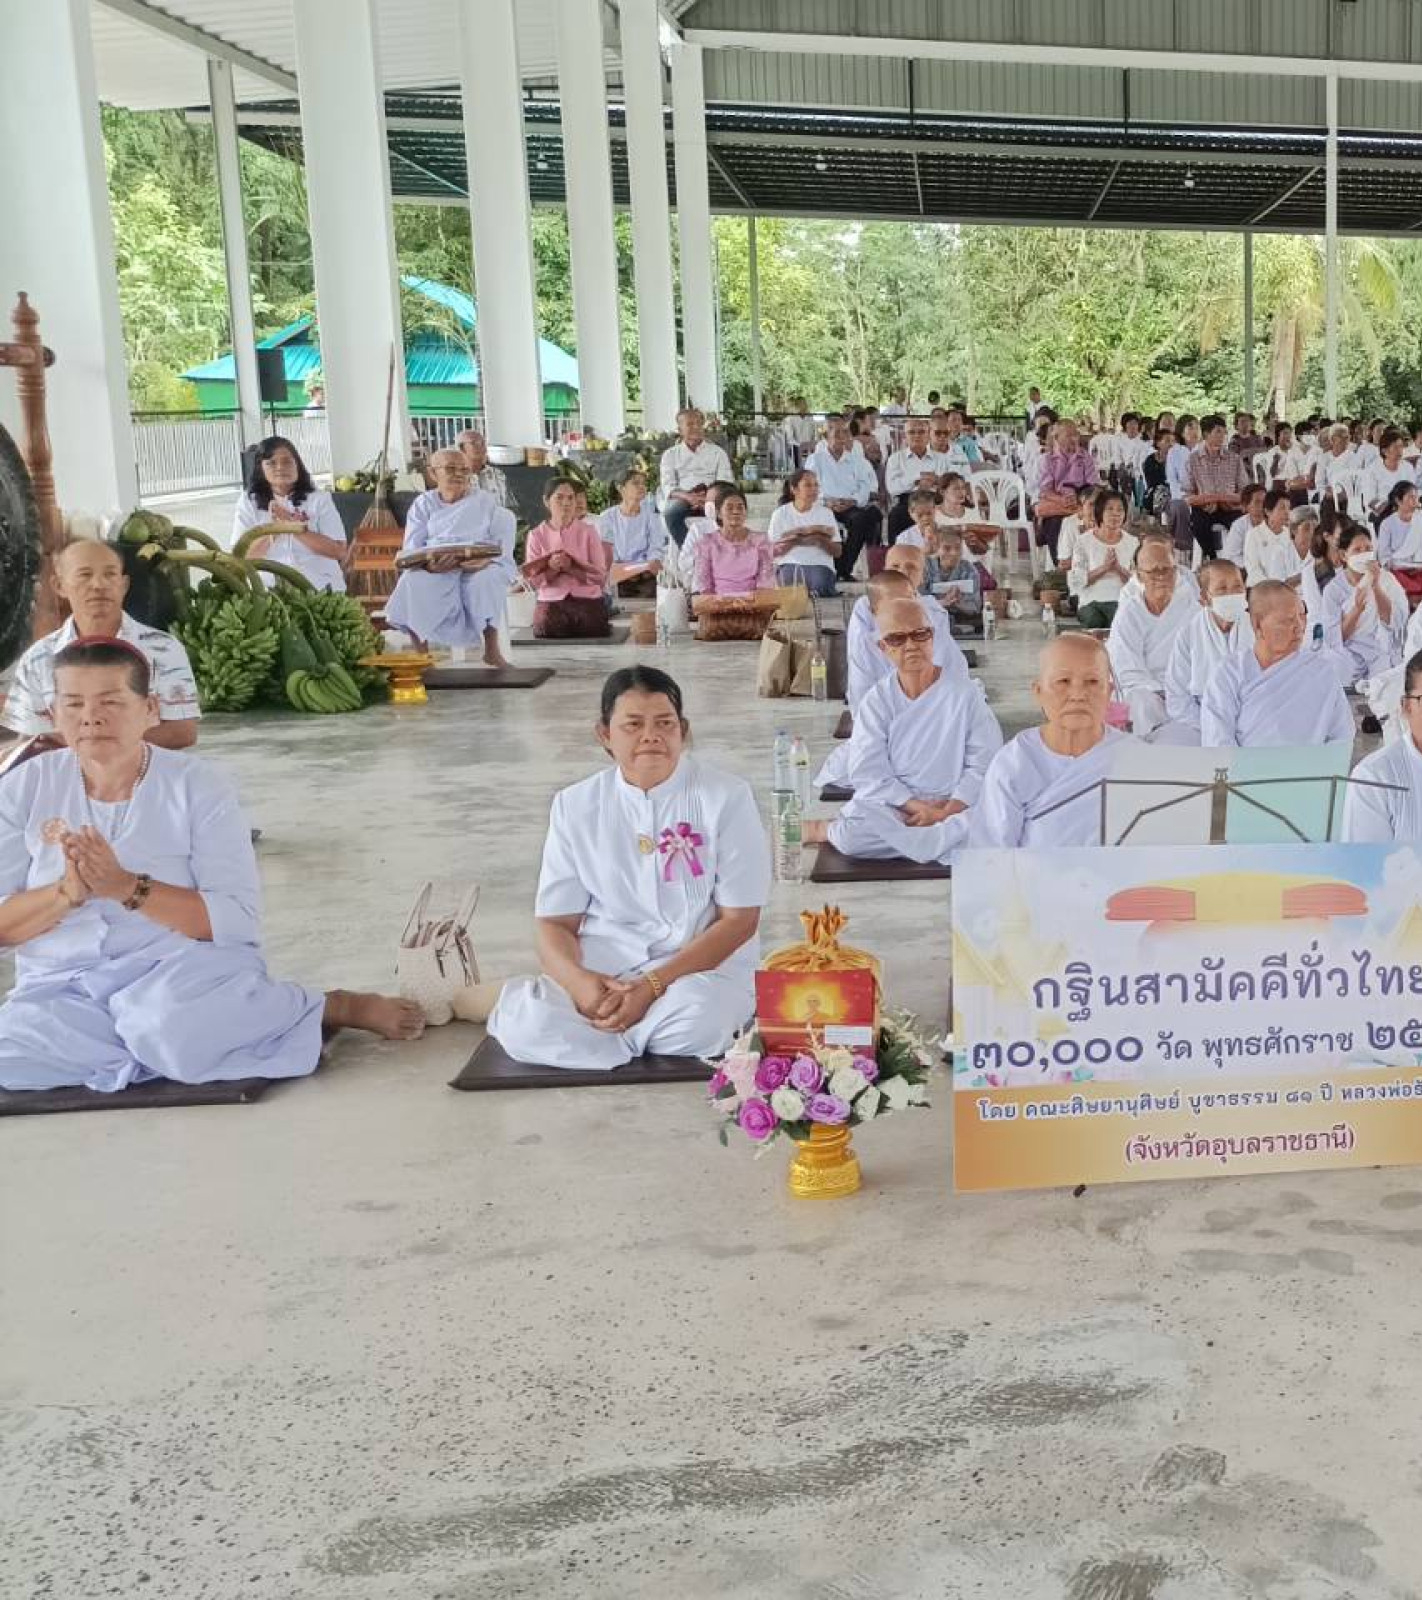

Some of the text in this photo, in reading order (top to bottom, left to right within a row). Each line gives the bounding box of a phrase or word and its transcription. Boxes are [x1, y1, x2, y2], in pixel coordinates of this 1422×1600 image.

[972, 1036, 1144, 1073] ๓๐,๐๐๐
[1156, 1030, 1193, 1060] วัด
[1201, 1026, 1354, 1069] พุทธศักราช
[978, 1100, 1016, 1120] โดย
[1026, 1089, 1180, 1118] คณะศิษยานุศิษย์
[1188, 1091, 1278, 1115] บูชาธรรม
[1319, 1082, 1334, 1101] ปี
[1125, 1122, 1356, 1164] (จังหวัดอุบลราชธานี)
